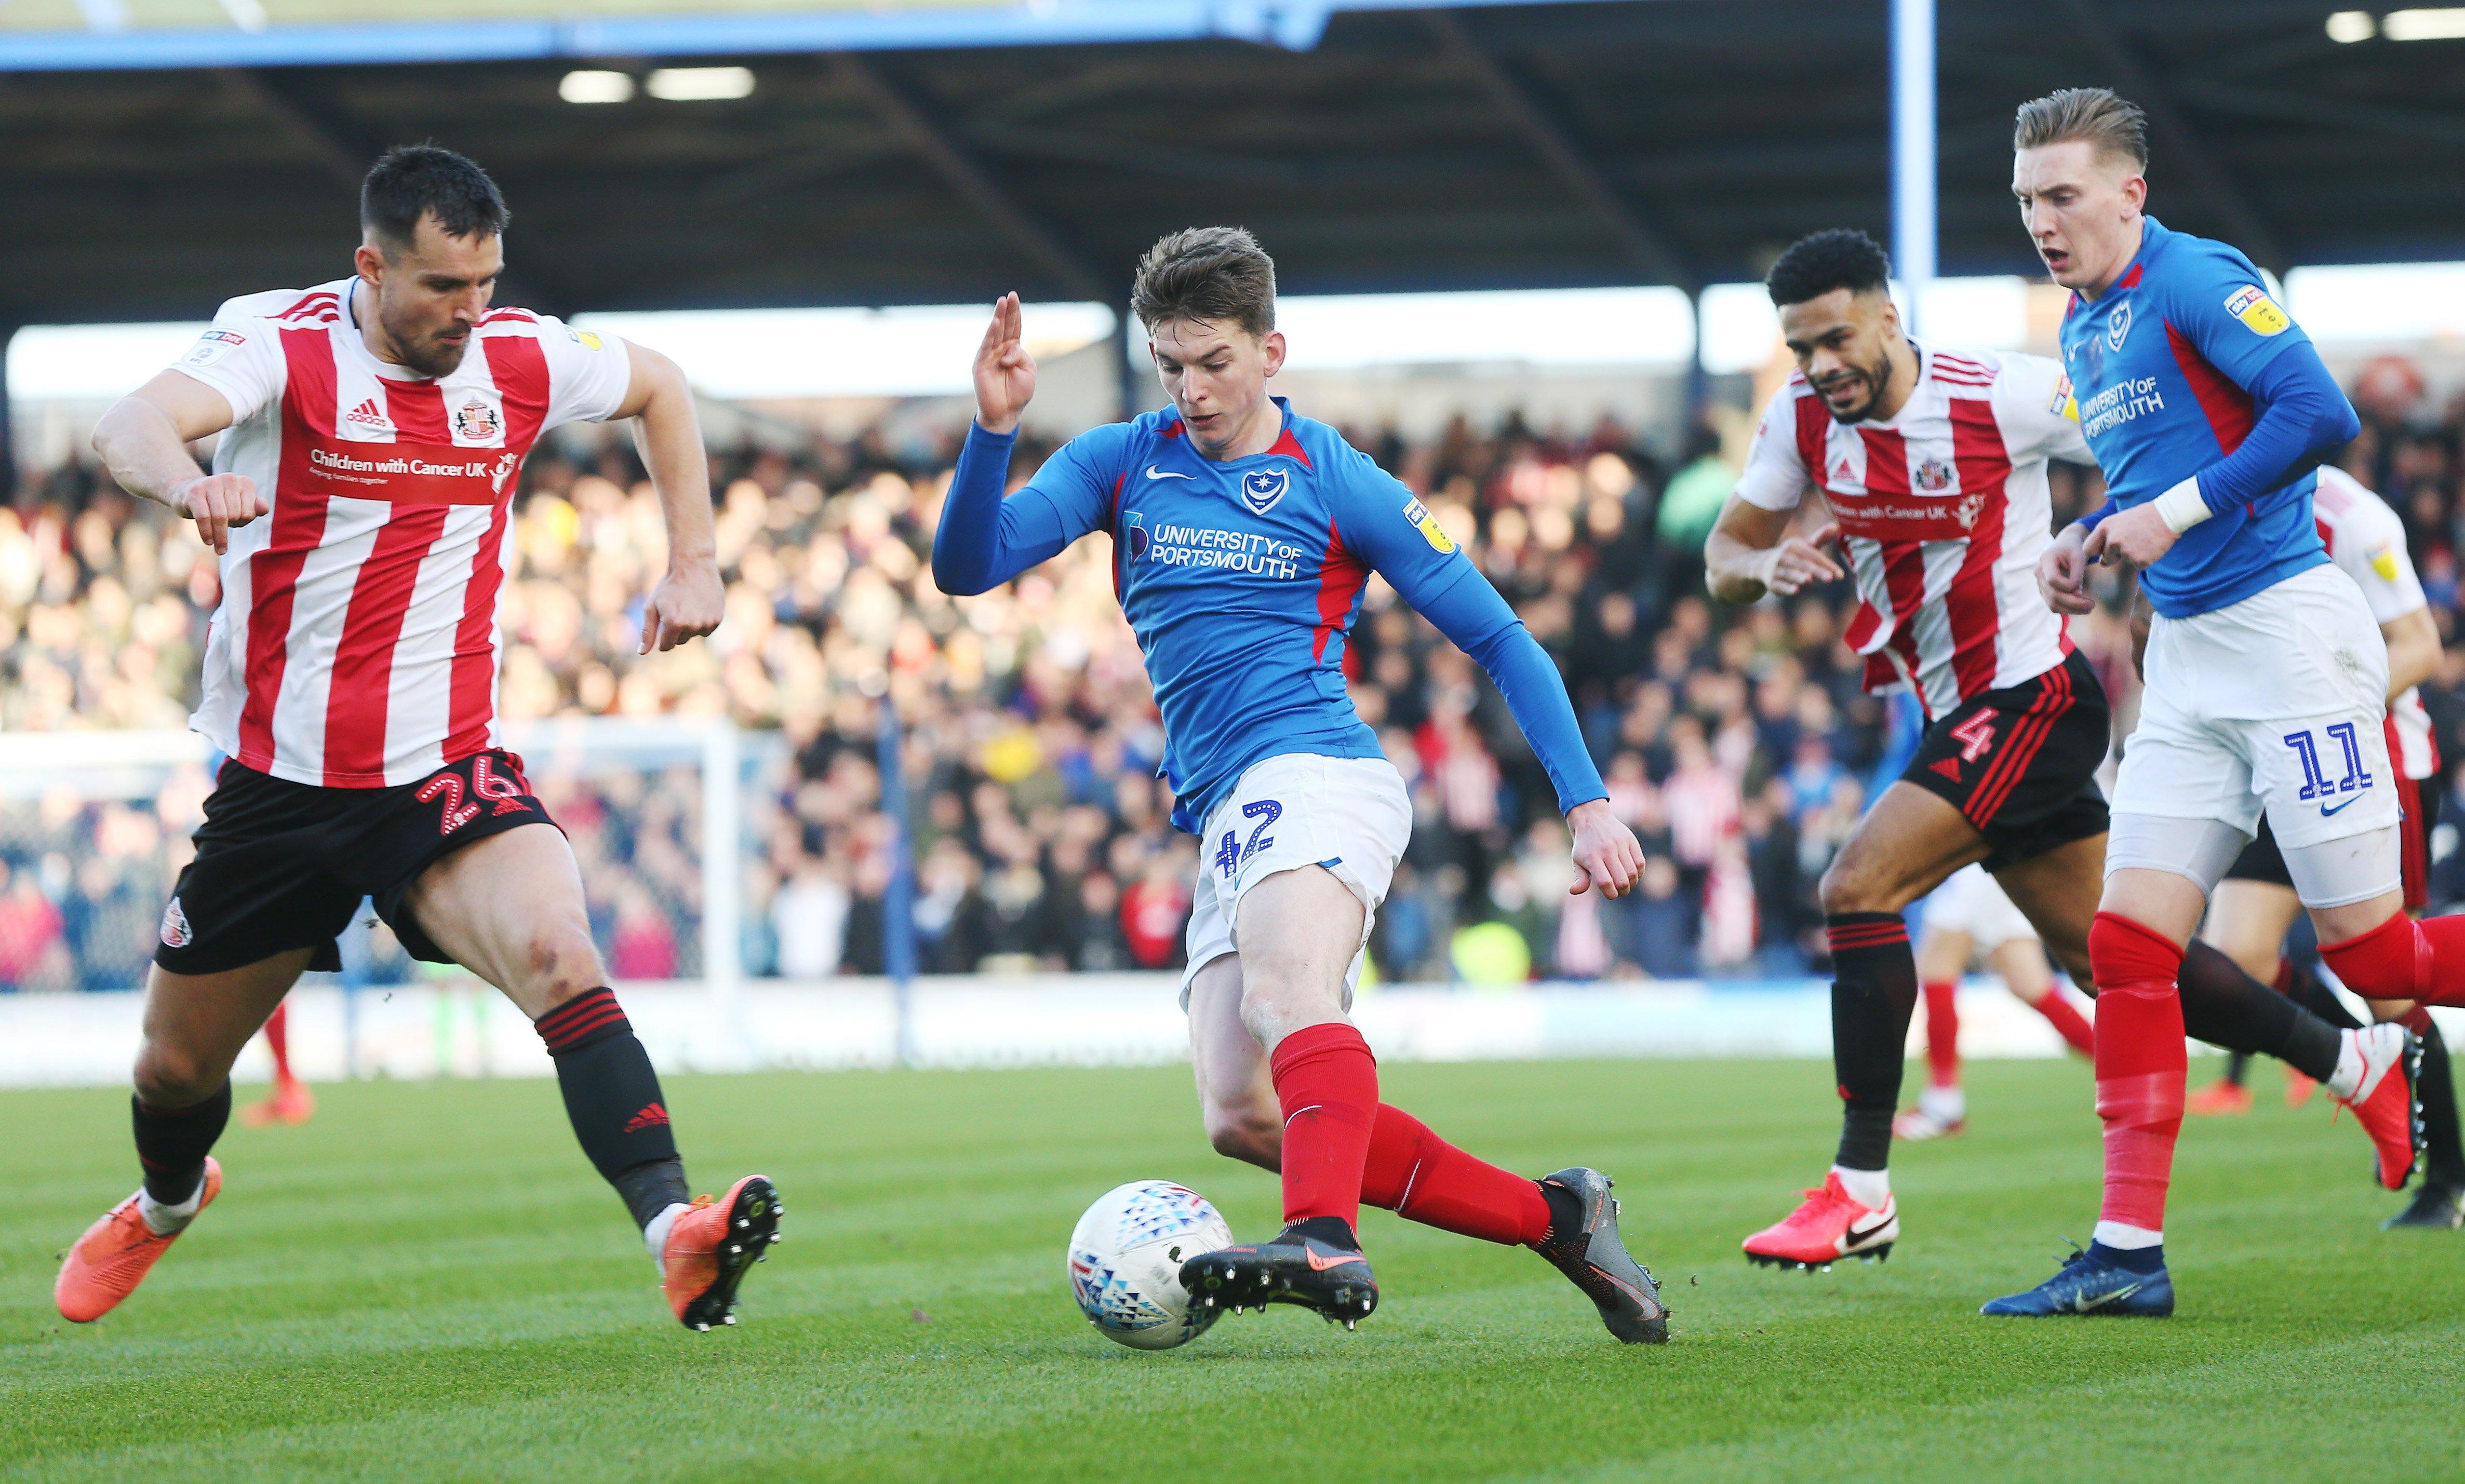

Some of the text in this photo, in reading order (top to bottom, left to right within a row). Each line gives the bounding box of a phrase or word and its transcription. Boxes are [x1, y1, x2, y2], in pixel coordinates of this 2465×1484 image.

[2231, 296, 2249, 314] sky
[2082, 376, 2157, 421] UNIVERSITY OF
[2085, 392, 2165, 440] PORTSMOUTH
[347, 413, 386, 427] adidas
[311, 449, 487, 478] Children with Cancer UK
[1925, 505, 1948, 520] UK
[1150, 545, 1297, 580] PORTSMOUTH
[1154, 524, 1303, 561] UNIVERSITY OF
[1949, 706, 2000, 764] 4
[2284, 722, 2373, 801] 11
[414, 755, 521, 836] 26
[1215, 800, 1282, 879] 42
